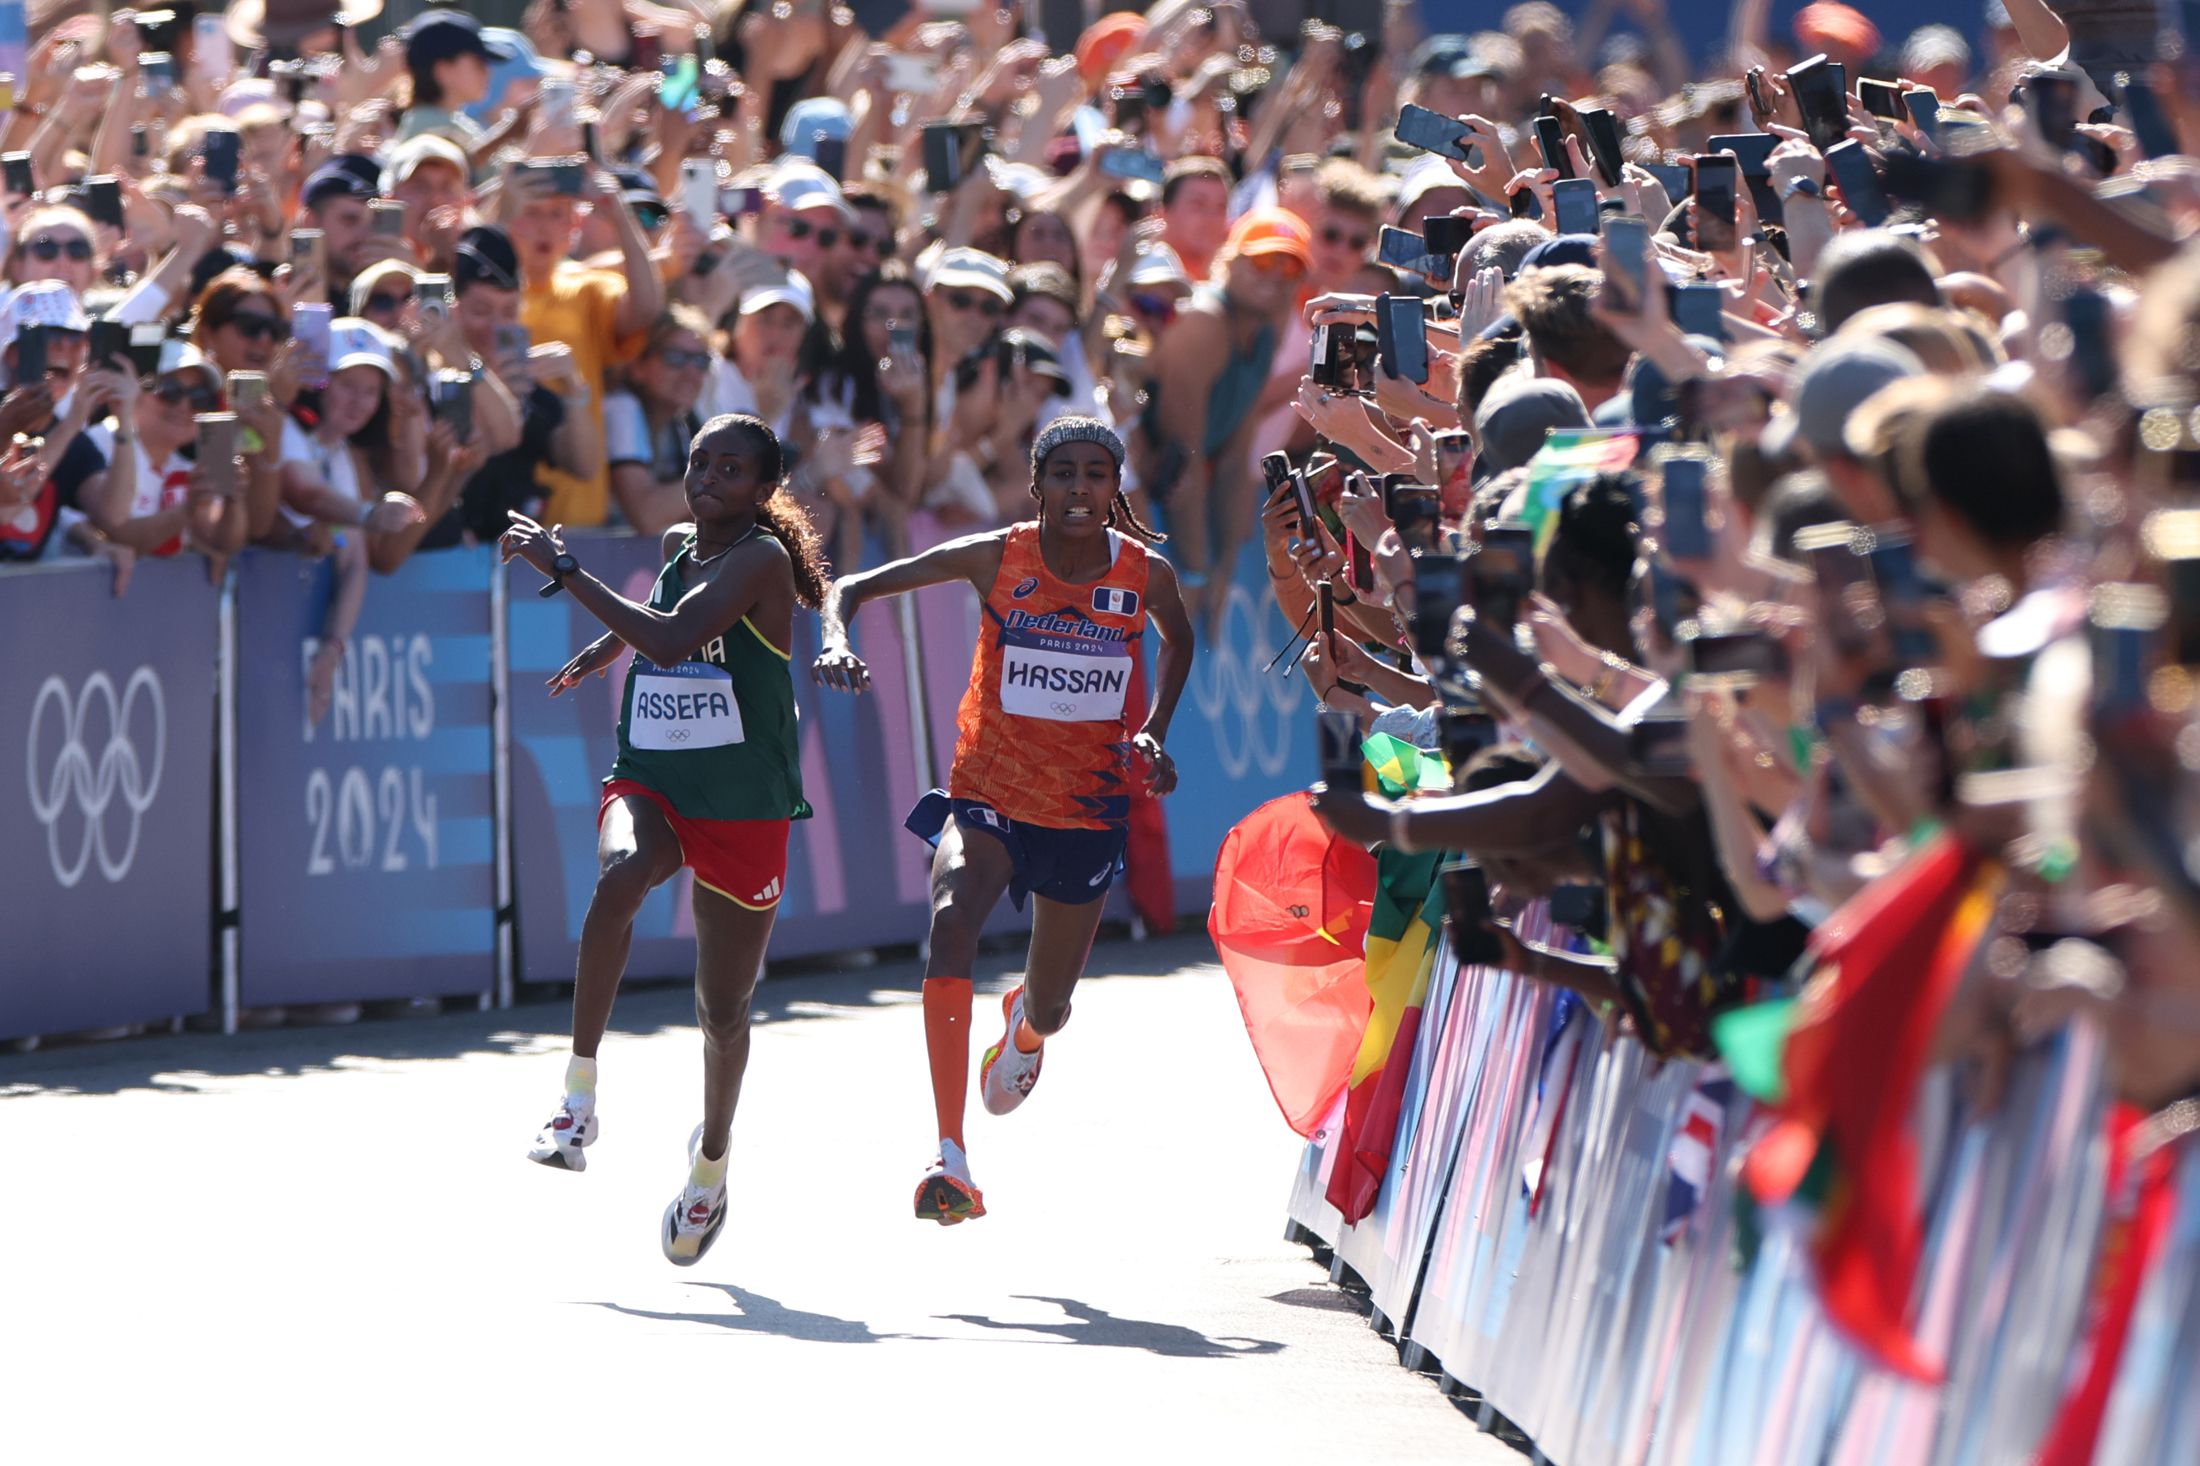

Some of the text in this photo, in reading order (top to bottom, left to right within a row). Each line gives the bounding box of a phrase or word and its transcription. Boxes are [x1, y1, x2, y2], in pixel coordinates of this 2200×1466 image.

[1075, 642, 1104, 653] 2024
[1008, 661, 1125, 694] HASSAN
[637, 691, 730, 721] ASSEFA
[305, 766, 439, 875] 2024
